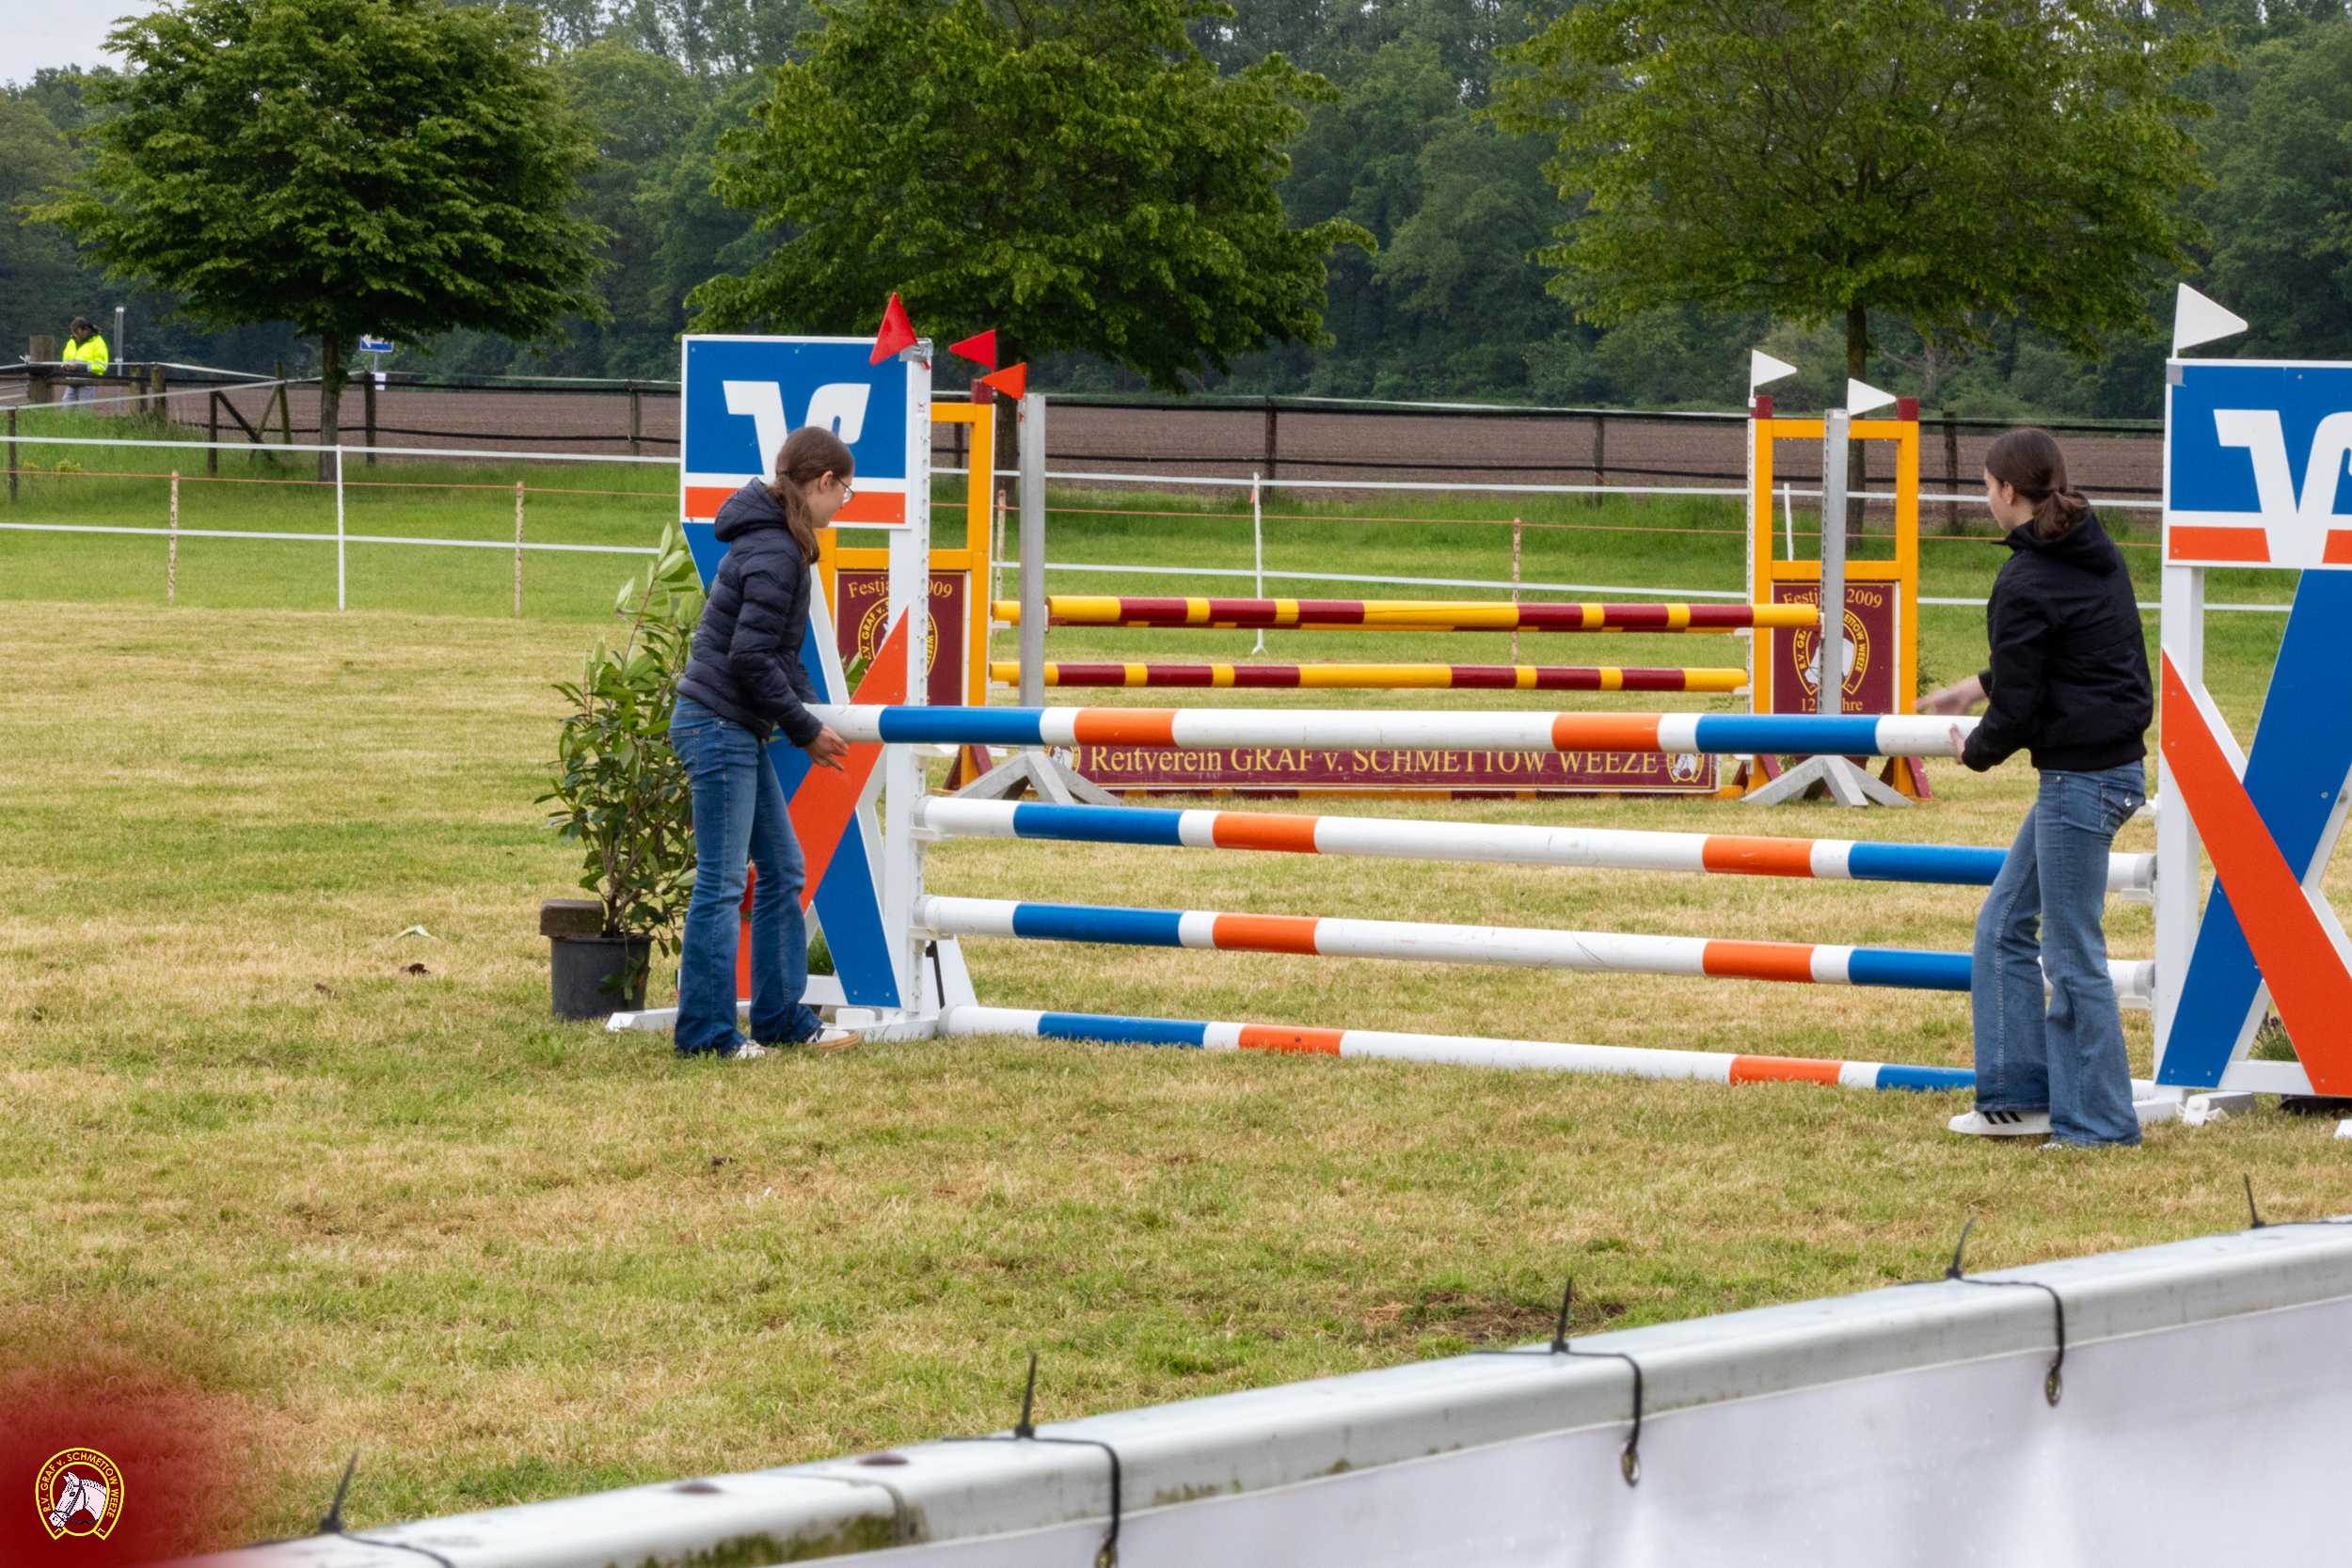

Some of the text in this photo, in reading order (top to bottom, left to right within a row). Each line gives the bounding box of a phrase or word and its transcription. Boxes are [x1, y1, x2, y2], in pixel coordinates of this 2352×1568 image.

[848, 577, 889, 598] Festj
[1846, 589, 1883, 608] 2009
[862, 612, 877, 640] GRAF
[1844, 613, 1865, 640] ETTOW
[1856, 643, 1867, 673] WEEZE
[1801, 697, 1863, 712] 12 hre
[1089, 746, 1222, 772] Reitverein
[1231, 748, 1312, 771] GRAF
[1323, 752, 1343, 771] v.
[1558, 752, 1660, 774] WEEZE
